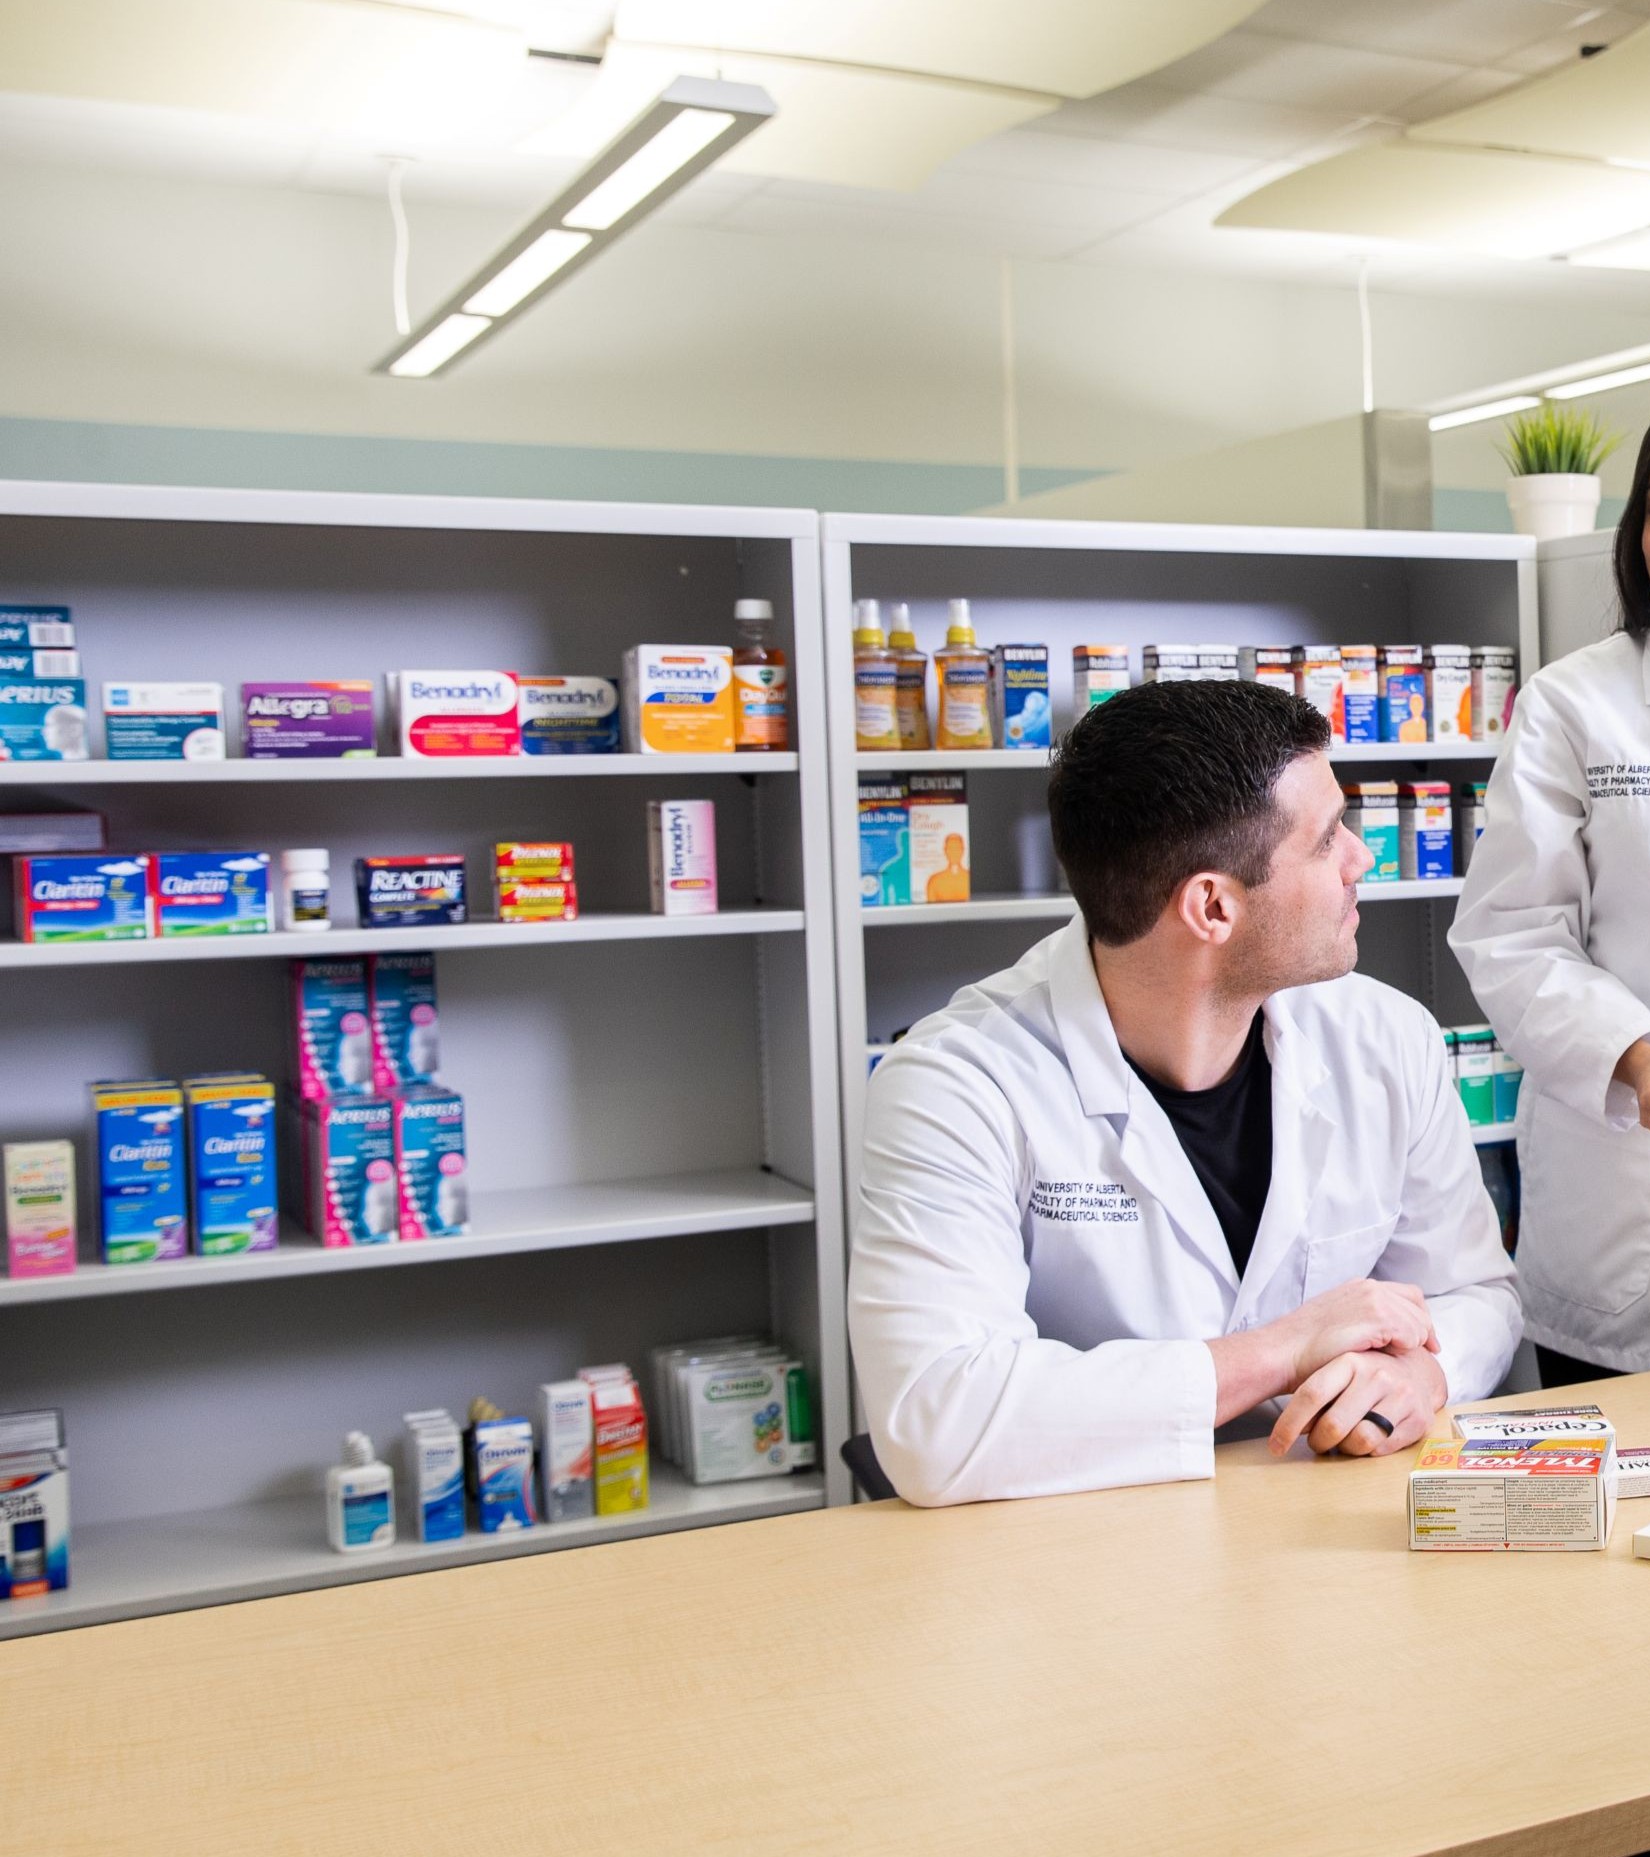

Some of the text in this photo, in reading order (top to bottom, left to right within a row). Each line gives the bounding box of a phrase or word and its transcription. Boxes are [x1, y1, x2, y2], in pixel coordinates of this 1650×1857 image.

[647, 664, 719, 684] Benadryl
[410, 681, 501, 704] Benadryl
[525, 688, 604, 708] Benadryl
[247, 695, 329, 719] Allegra
[1617, 765, 1625, 774] OF
[1601, 778, 1608, 787] OF
[1611, 776, 1650, 786] PHARMACY
[667, 807, 686, 877] Benadryl
[369, 870, 464, 891] REACTINE
[1035, 1180, 1126, 1194] UNIVERSITY OF ALBERTA
[1065, 1197, 1076, 1208] OF
[1080, 1197, 1117, 1208] PHARMACY
[1120, 1198, 1137, 1209] AND
[1102, 1211, 1139, 1222] SCIENCES
[1502, 1420, 1608, 1437] Cepacol
[1421, 1454, 1454, 1466] 60
[1465, 1456, 1597, 1469] TYLENOL
